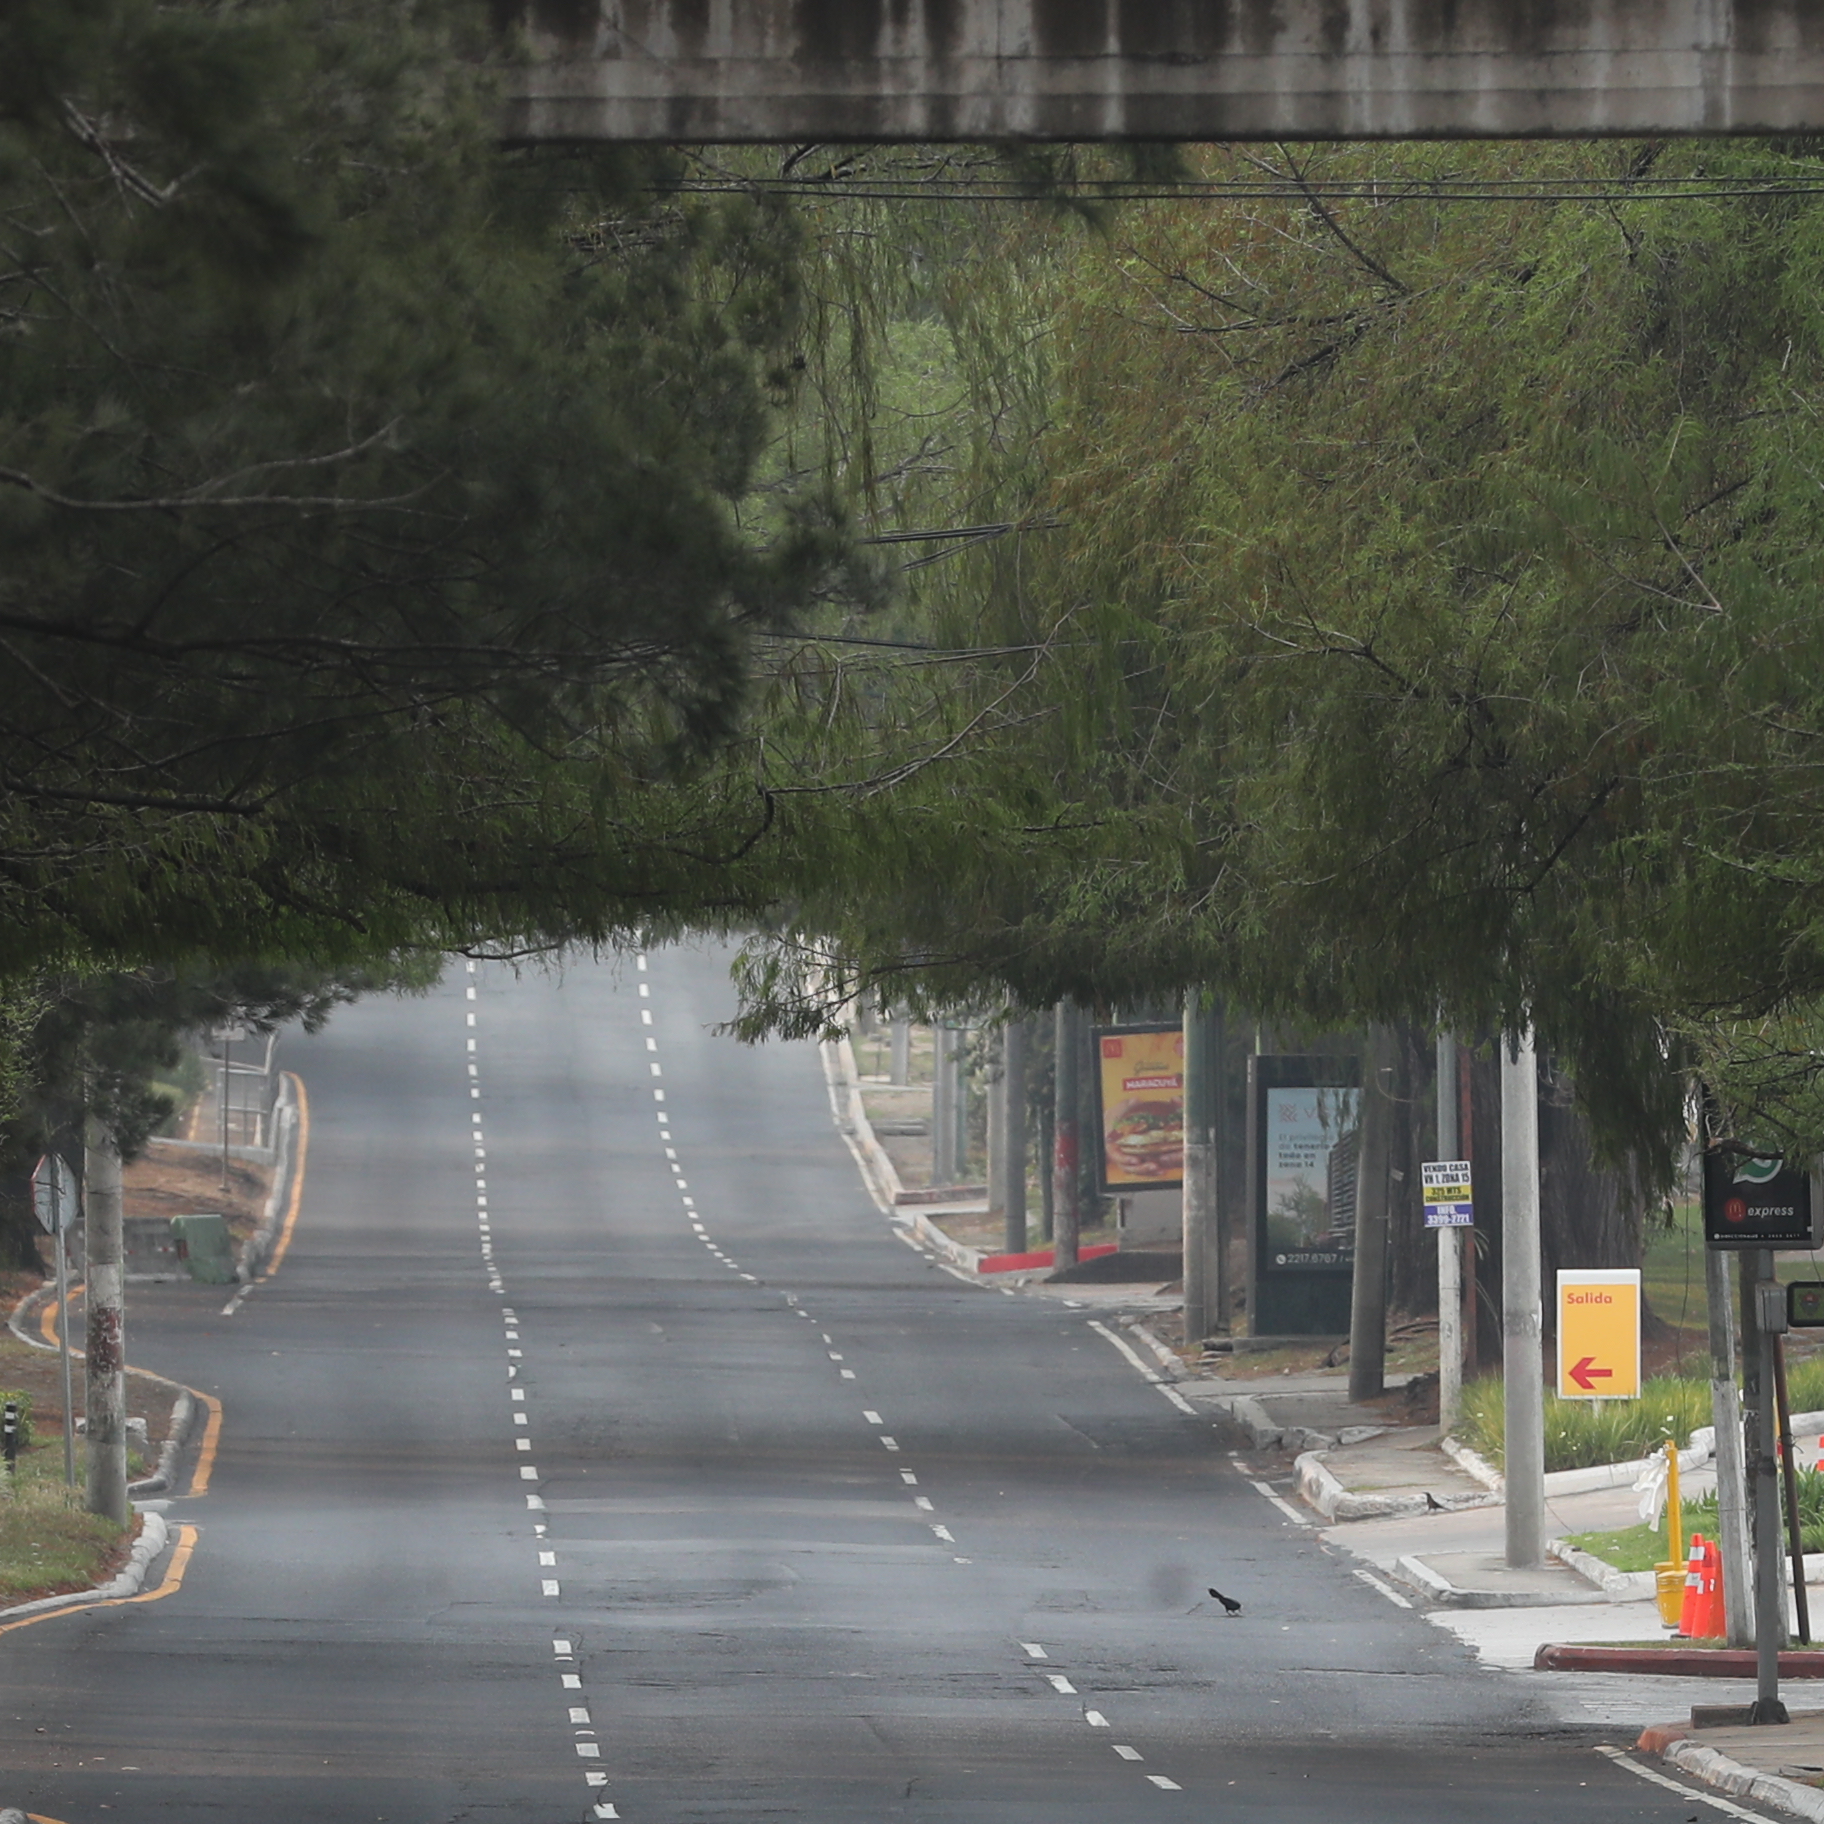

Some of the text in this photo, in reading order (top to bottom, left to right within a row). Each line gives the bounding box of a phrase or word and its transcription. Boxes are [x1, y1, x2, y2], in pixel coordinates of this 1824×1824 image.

[1423, 1163, 1469, 1173] VENDO CASA
[1442, 1173, 1460, 1183] ZONA
[1461, 1172, 1470, 1183] 15
[1747, 1206, 1794, 1218] express
[1567, 1292, 1612, 1304] Salida
